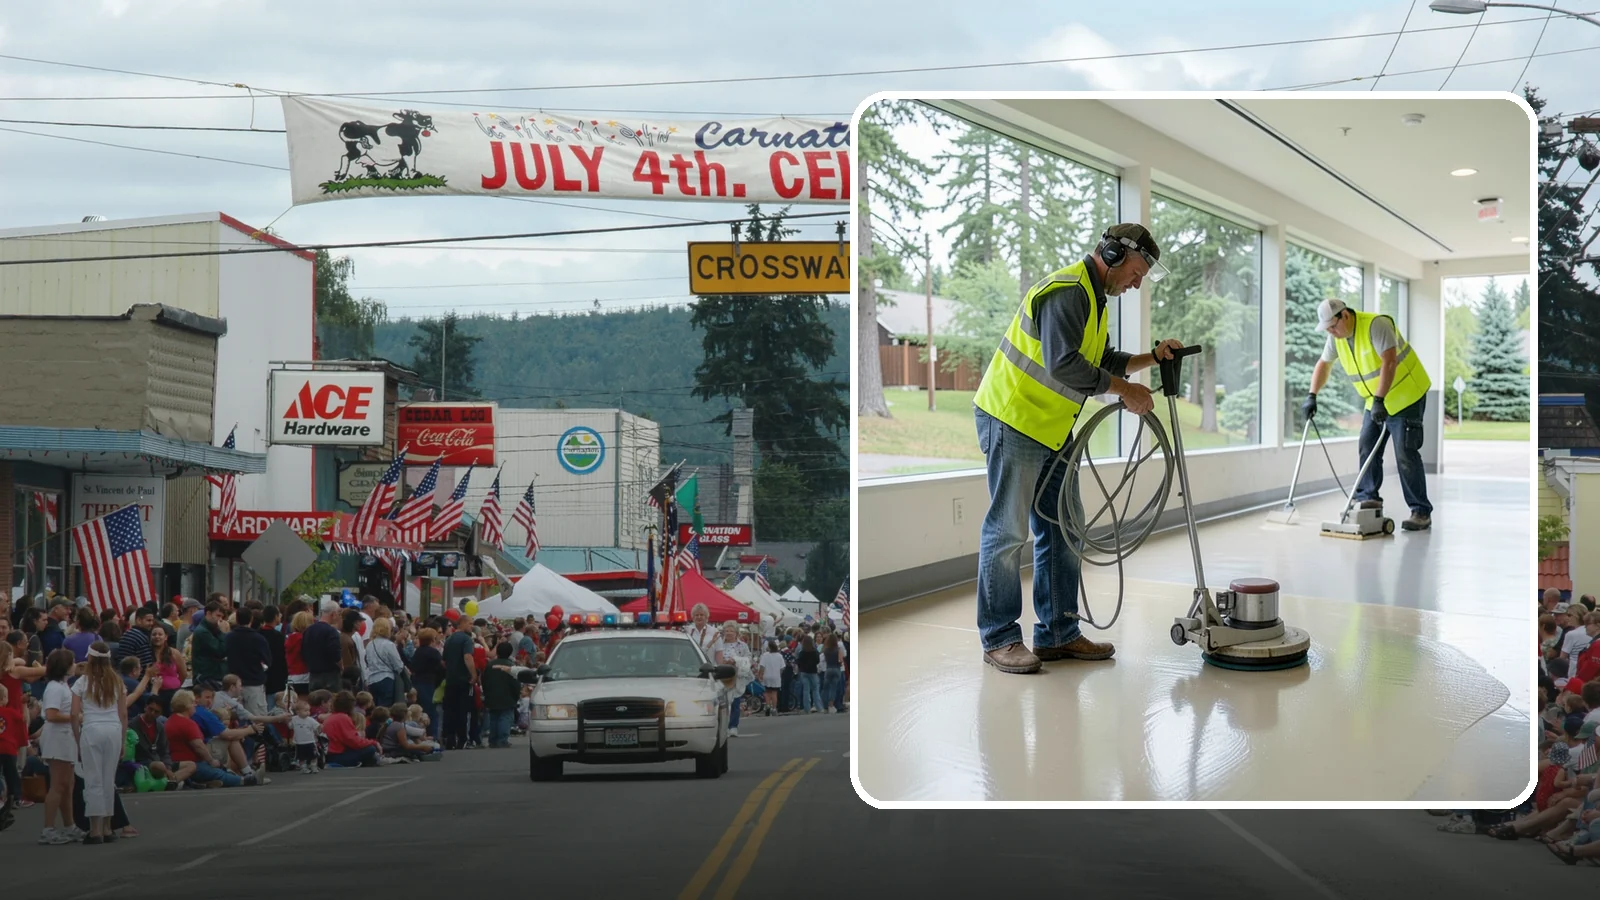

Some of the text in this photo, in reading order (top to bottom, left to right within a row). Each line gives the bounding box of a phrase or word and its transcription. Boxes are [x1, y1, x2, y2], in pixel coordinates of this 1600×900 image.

[481, 141, 604, 192] JULY
[632, 150, 746, 198] 4th.
[697, 254, 850, 280] CROSSWA
[283, 380, 374, 420] ACE
[405, 409, 452, 421] CEDAR
[283, 421, 371, 436] Hardware
[416, 428, 477, 447] Coca-Cola
[95, 484, 125, 494] Vincent
[126, 486, 135, 494] de
[137, 486, 155, 495] Paul
[688, 526, 742, 536] CRNATION
[699, 535, 731, 544] GLASS
